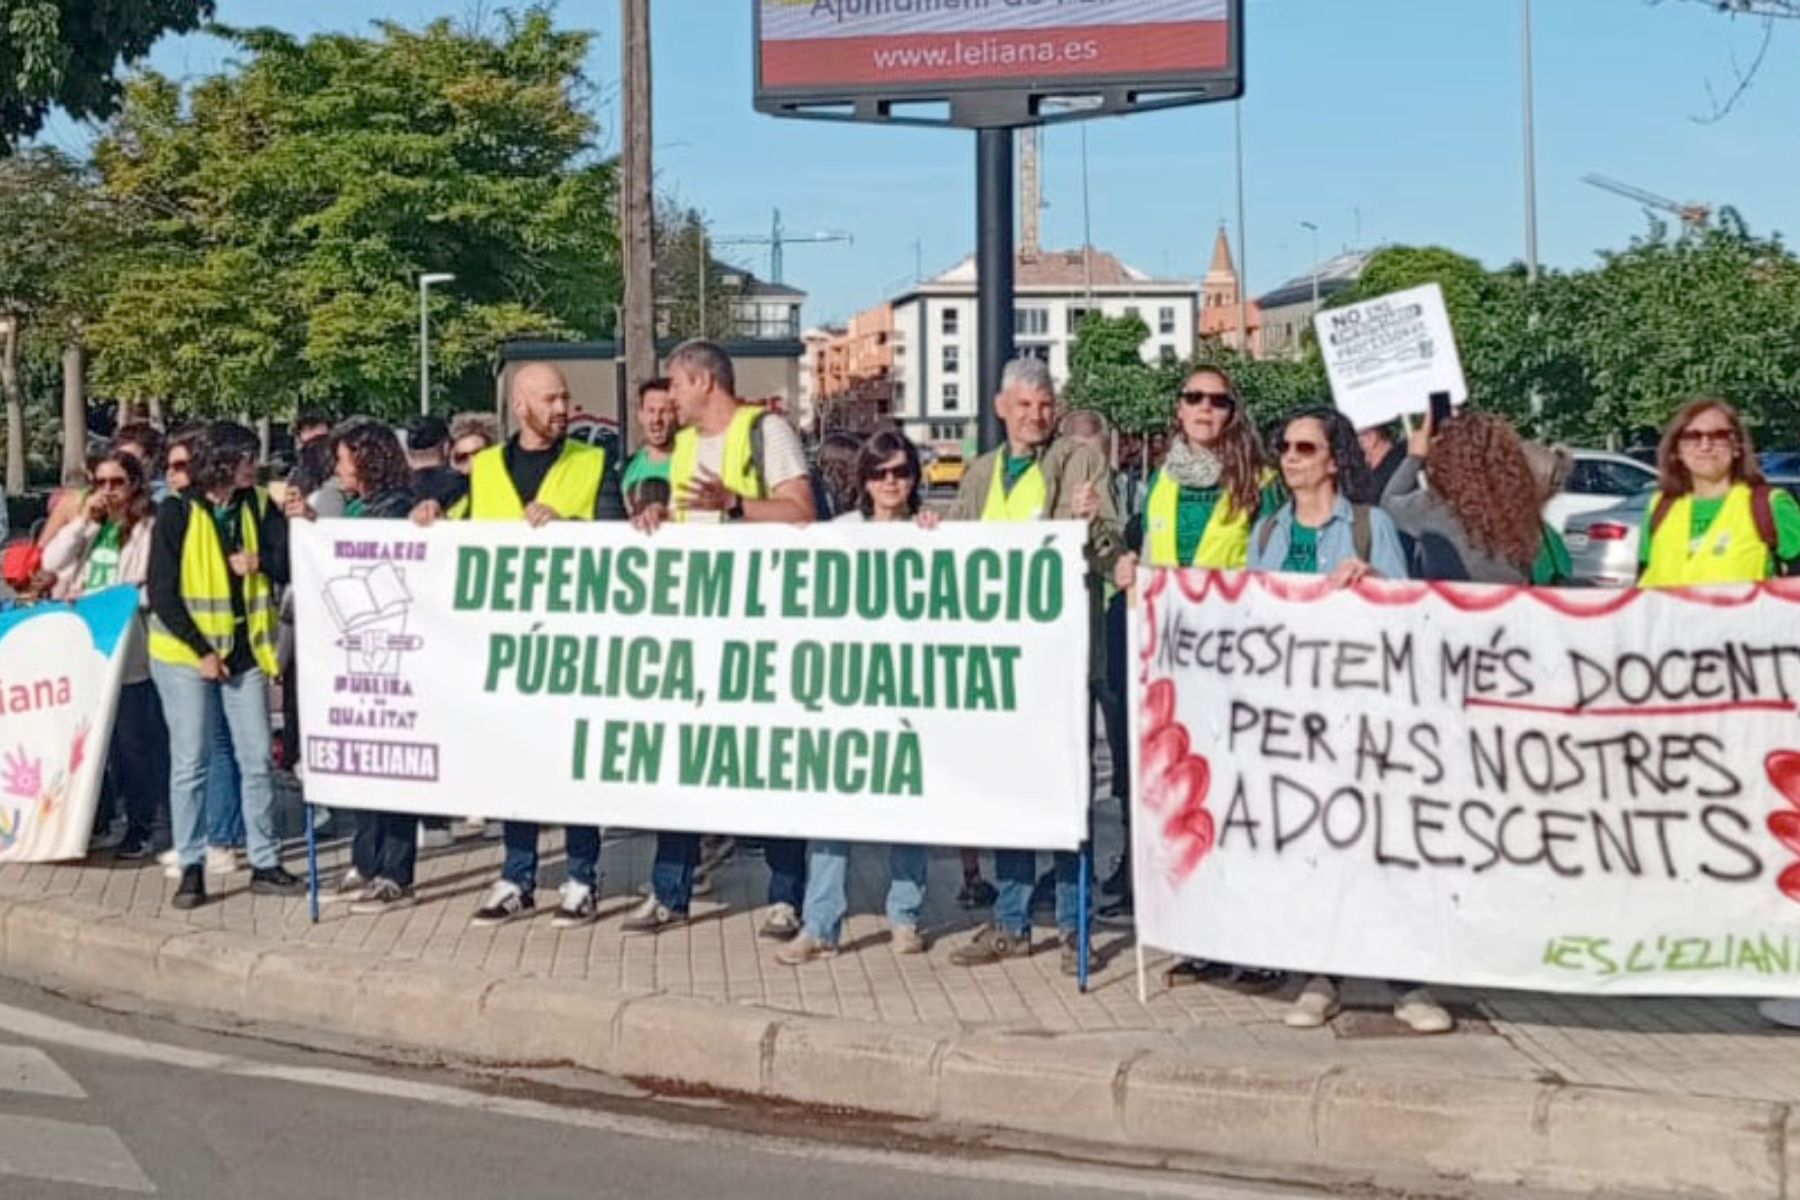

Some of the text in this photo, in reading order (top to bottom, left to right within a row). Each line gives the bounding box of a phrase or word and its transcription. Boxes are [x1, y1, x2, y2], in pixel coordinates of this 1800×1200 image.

[873, 38, 1098, 68] www.leliana.es
[453, 534, 1064, 623] DEFENSEM L'EDUCACIÓ
[484, 621, 1021, 711] PÚBLICA, DE QUALITAT
[1158, 611, 1800, 710] NECESSITEM MÉS DOCENT
[310, 739, 339, 770] IES
[572, 717, 924, 796] I EN VALENCIÀ
[1230, 700, 1742, 800] PER ALS NOSTRES
[1218, 773, 1765, 882] ADOLESCENTS
[1542, 932, 1800, 976] IES L'ELIAN
